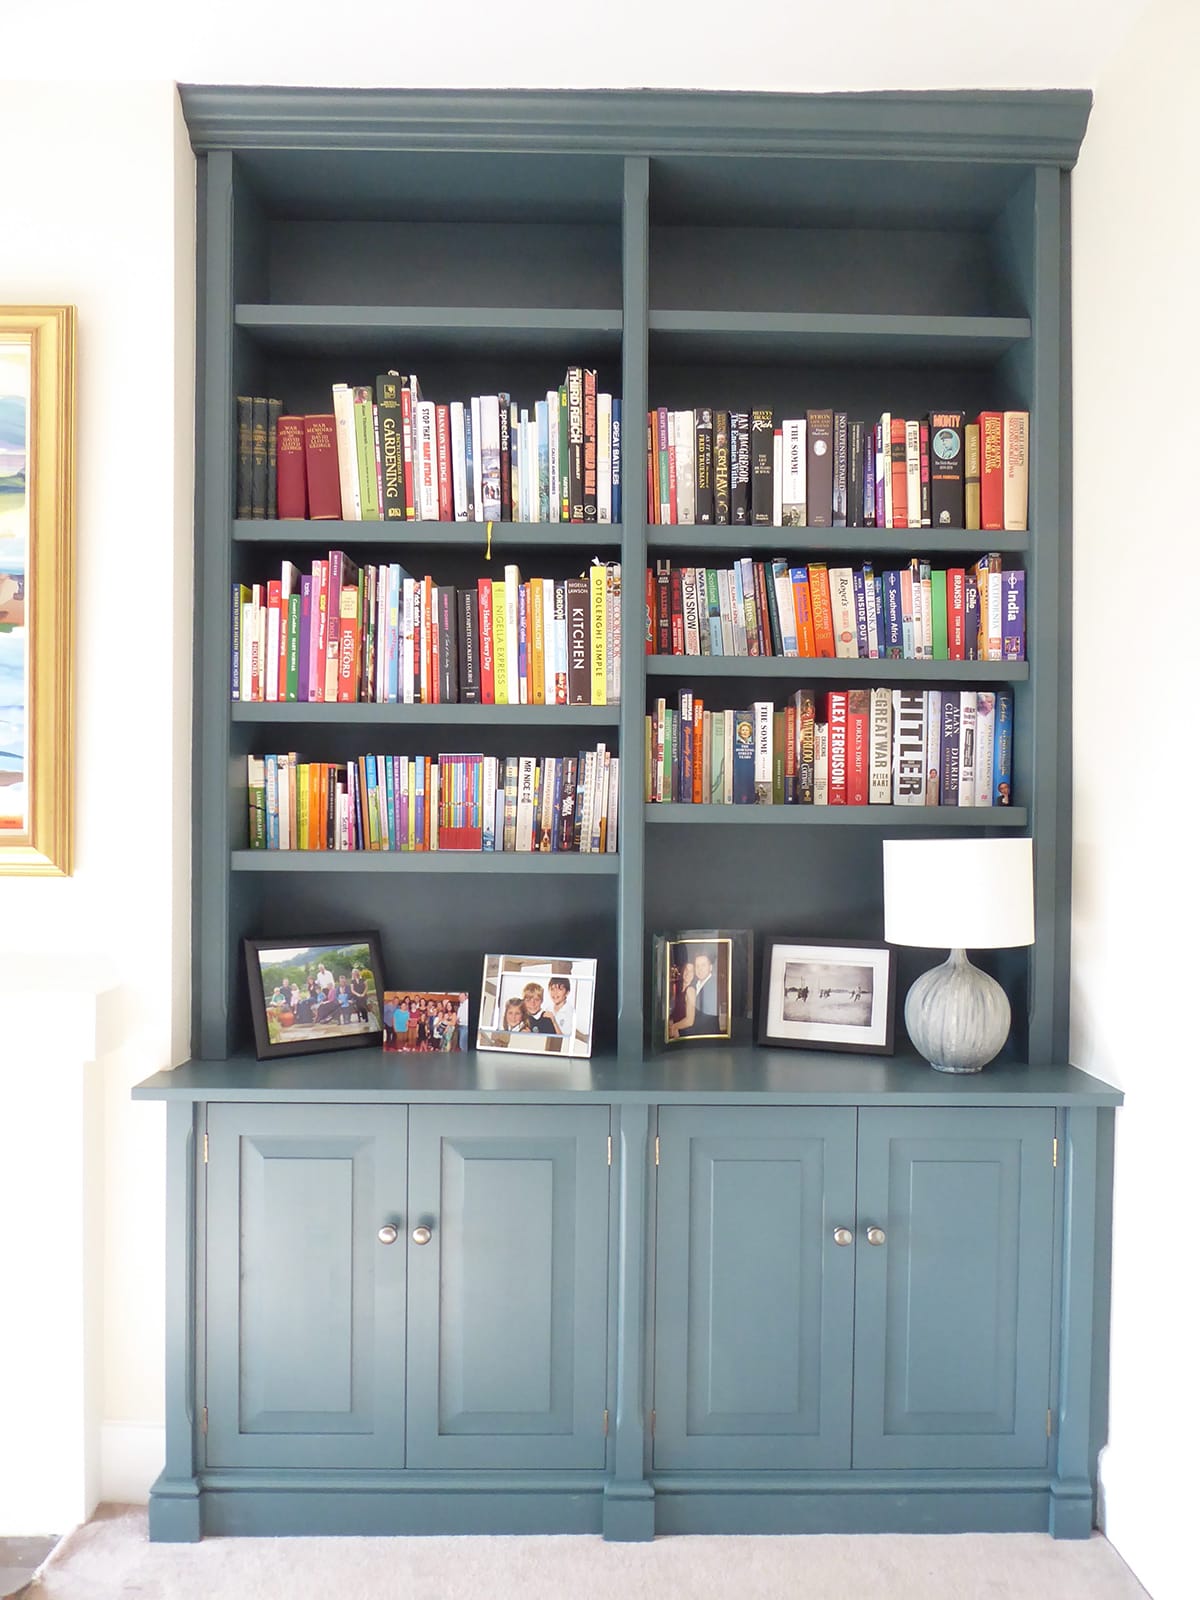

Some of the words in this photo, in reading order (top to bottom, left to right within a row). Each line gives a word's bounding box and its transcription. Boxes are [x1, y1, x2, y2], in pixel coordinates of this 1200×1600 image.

[569, 369, 580, 405] THIRD
[422, 408, 430, 424] STOP
[438, 408, 446, 433] DIANA
[500, 409, 509, 451] speeches
[570, 406, 581, 443] REICH
[738, 413, 749, 429] IAN
[752, 420, 773, 432] Rich
[839, 416, 846, 428] NO
[933, 414, 961, 428] MONTY
[423, 425, 431, 440] THAT
[439, 434, 446, 443] ON
[612, 421, 620, 447] GREAT
[705, 434, 711, 442] AS
[791, 424, 799, 442] THE
[384, 418, 397, 498] GARDENING
[423, 441, 431, 461] HEART
[585, 442, 596, 469] WORLD
[718, 448, 727, 467] CRY
[791, 444, 799, 475] SOMME
[440, 461, 448, 482] EDGE
[585, 470, 596, 487] WAR
[612, 449, 620, 485] BATTLES
[731, 463, 739, 489] Within
[684, 581, 694, 600] JON
[698, 570, 706, 597] WAR
[708, 572, 717, 603] Scotland
[838, 578, 849, 608] Roget's
[866, 582, 874, 598] SRI
[954, 574, 962, 610] BRANSON
[555, 587, 564, 620] GORDON
[595, 579, 603, 639] OTTOLENGHI
[745, 592, 754, 622] Wines
[811, 573, 824, 631] YEARBOOK
[857, 593, 866, 622] INSIDE
[888, 589, 897, 622] Southern
[913, 585, 921, 614] PRAGUE
[969, 588, 977, 609] Chile
[991, 575, 1000, 630] CALIFORNIA
[1007, 590, 1020, 621] India
[329, 616, 339, 640] Food
[465, 612, 473, 637] COMPLETE
[482, 609, 490, 635] Healthy
[495, 605, 504, 643] NIGELLA
[686, 601, 696, 630] SNOW
[867, 599, 876, 632] LANKA
[482, 636, 491, 656] Every
[572, 608, 585, 669] KITCHEN
[859, 624, 867, 641] OUT
[890, 623, 898, 643] Africa
[342, 630, 353, 678] HOLFORD
[483, 656, 492, 670] Day
[497, 647, 506, 685] EXPRESS
[595, 644, 603, 677] SIMPLE
[760, 706, 768, 724] THE
[831, 695, 846, 723] ALEX
[874, 699, 889, 738] GREAT
[944, 703, 953, 738] CLARK
[953, 706, 961, 734] ALAN
[760, 725, 768, 755] SOMME
[802, 718, 814, 763] WATERLOO
[874, 740, 889, 768] WAR
[899, 689, 924, 796] HITLER
[524, 760, 532, 772] MR
[831, 726, 846, 784] FERGUSON
[951, 748, 959, 790] DIARIES
[523, 775, 531, 791] NICE
[872, 779, 888, 787] HART
